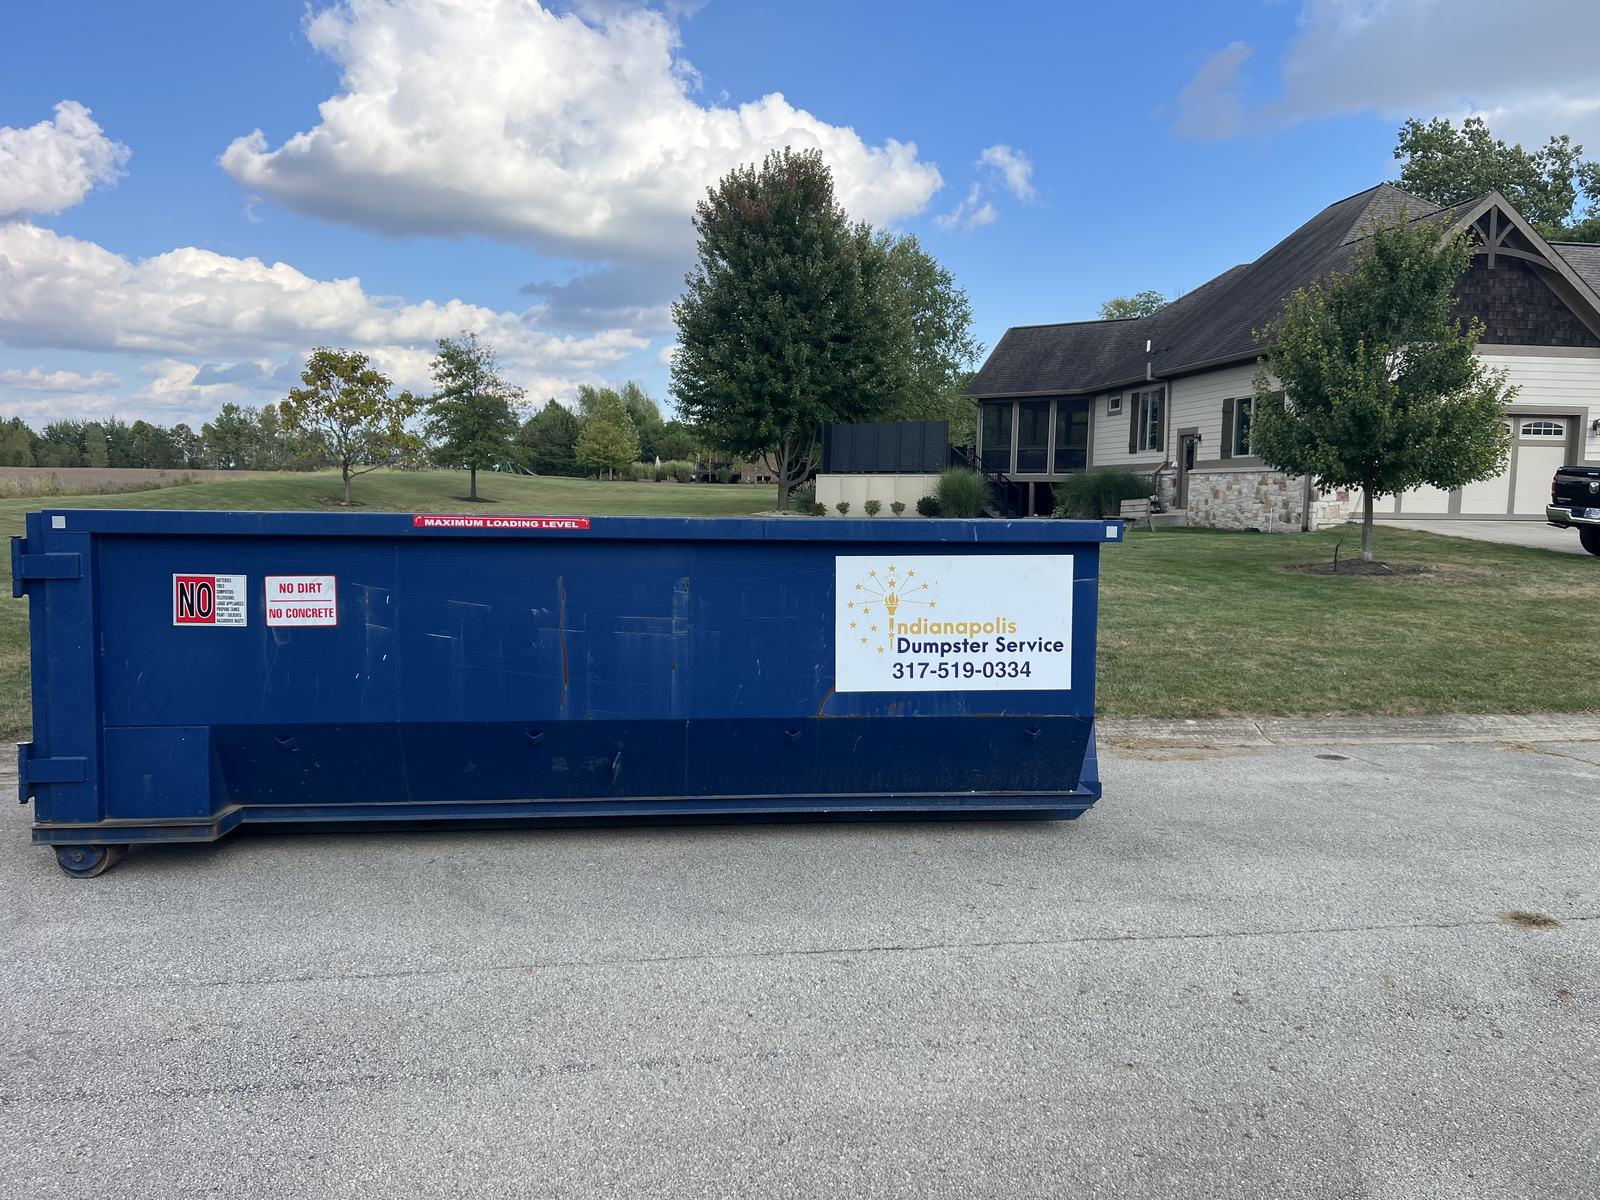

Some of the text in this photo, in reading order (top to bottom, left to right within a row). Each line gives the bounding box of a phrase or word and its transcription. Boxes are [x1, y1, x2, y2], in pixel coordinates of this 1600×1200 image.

[424, 519, 483, 527] MAXIMUM
[486, 520, 539, 528] LOADING
[279, 582, 323, 594] NO DIRT
[178, 581, 213, 619] NO
[269, 607, 334, 619] NO CONCRETE
[897, 636, 1064, 657] Dumpster Service
[892, 661, 1032, 680] 317-519-0334
